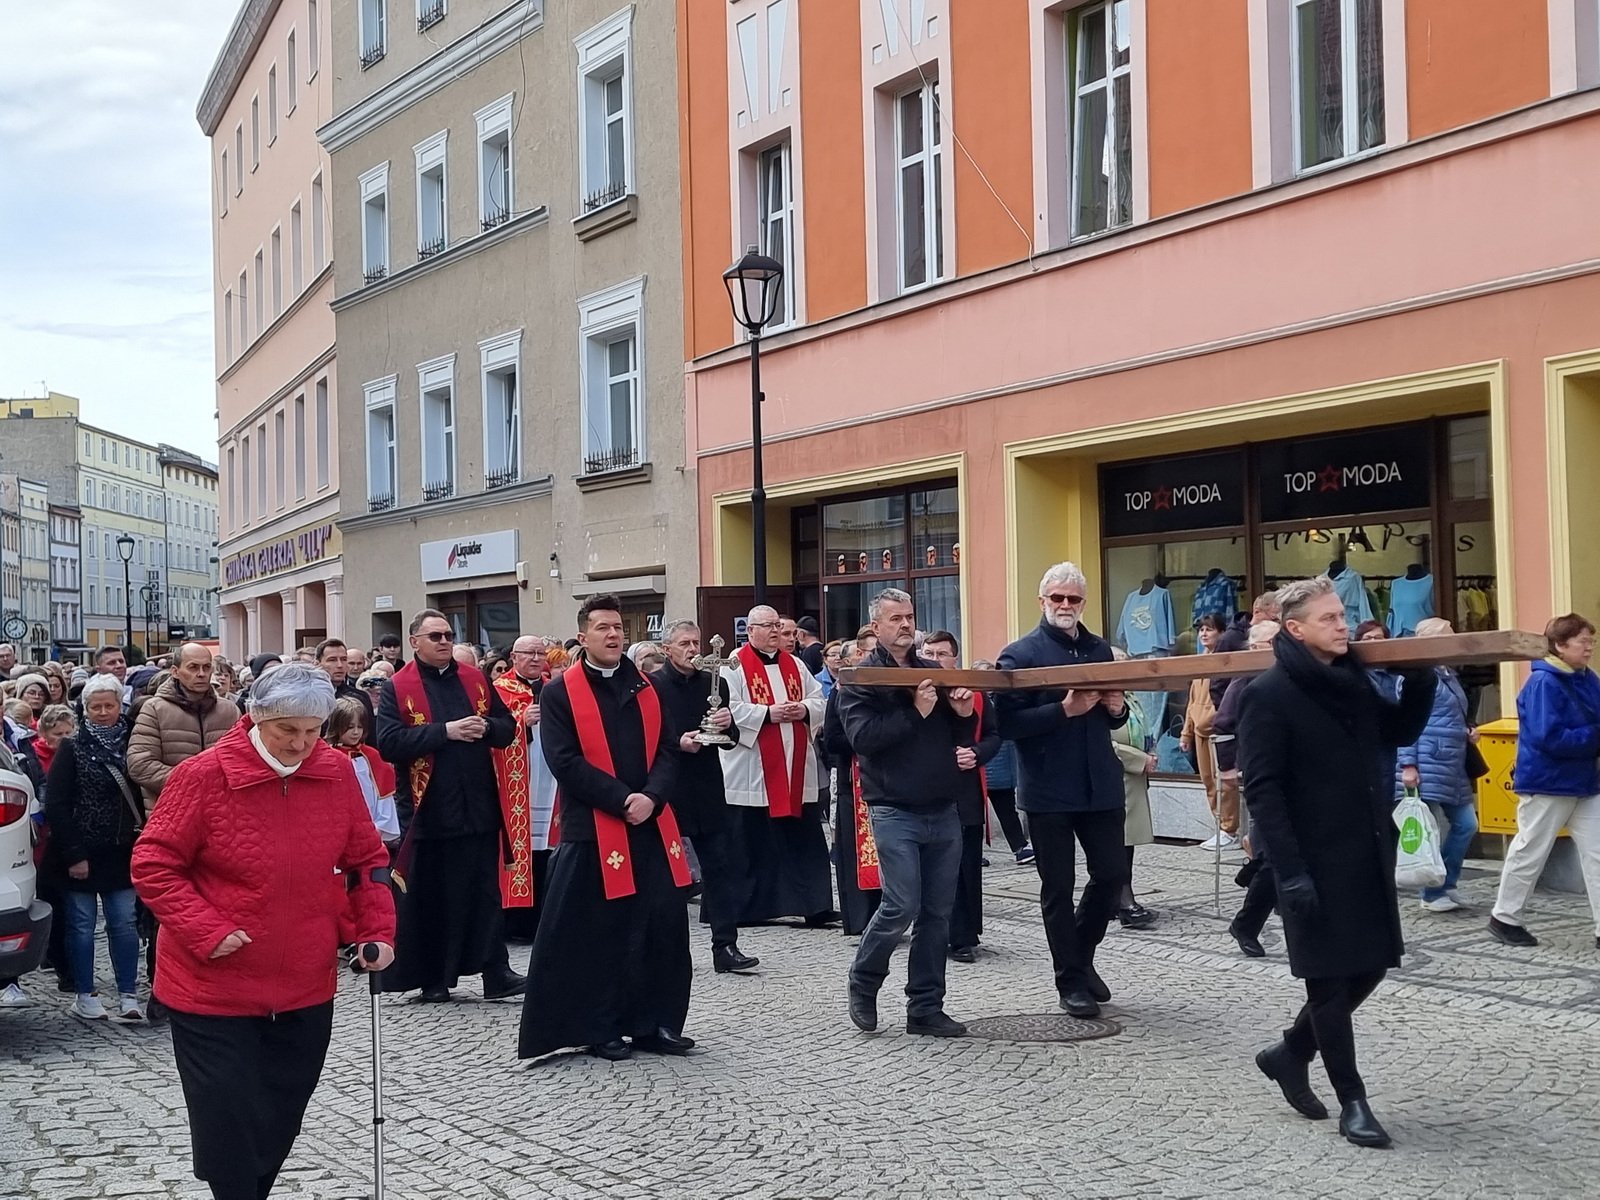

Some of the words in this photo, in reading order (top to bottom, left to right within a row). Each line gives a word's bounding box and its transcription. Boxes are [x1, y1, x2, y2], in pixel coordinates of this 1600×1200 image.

[1284, 471, 1316, 493] TOP
[1343, 461, 1402, 487] MODA
[1125, 491, 1152, 511] TOP
[1173, 483, 1222, 506] MODA
[259, 538, 297, 575] GALERIA
